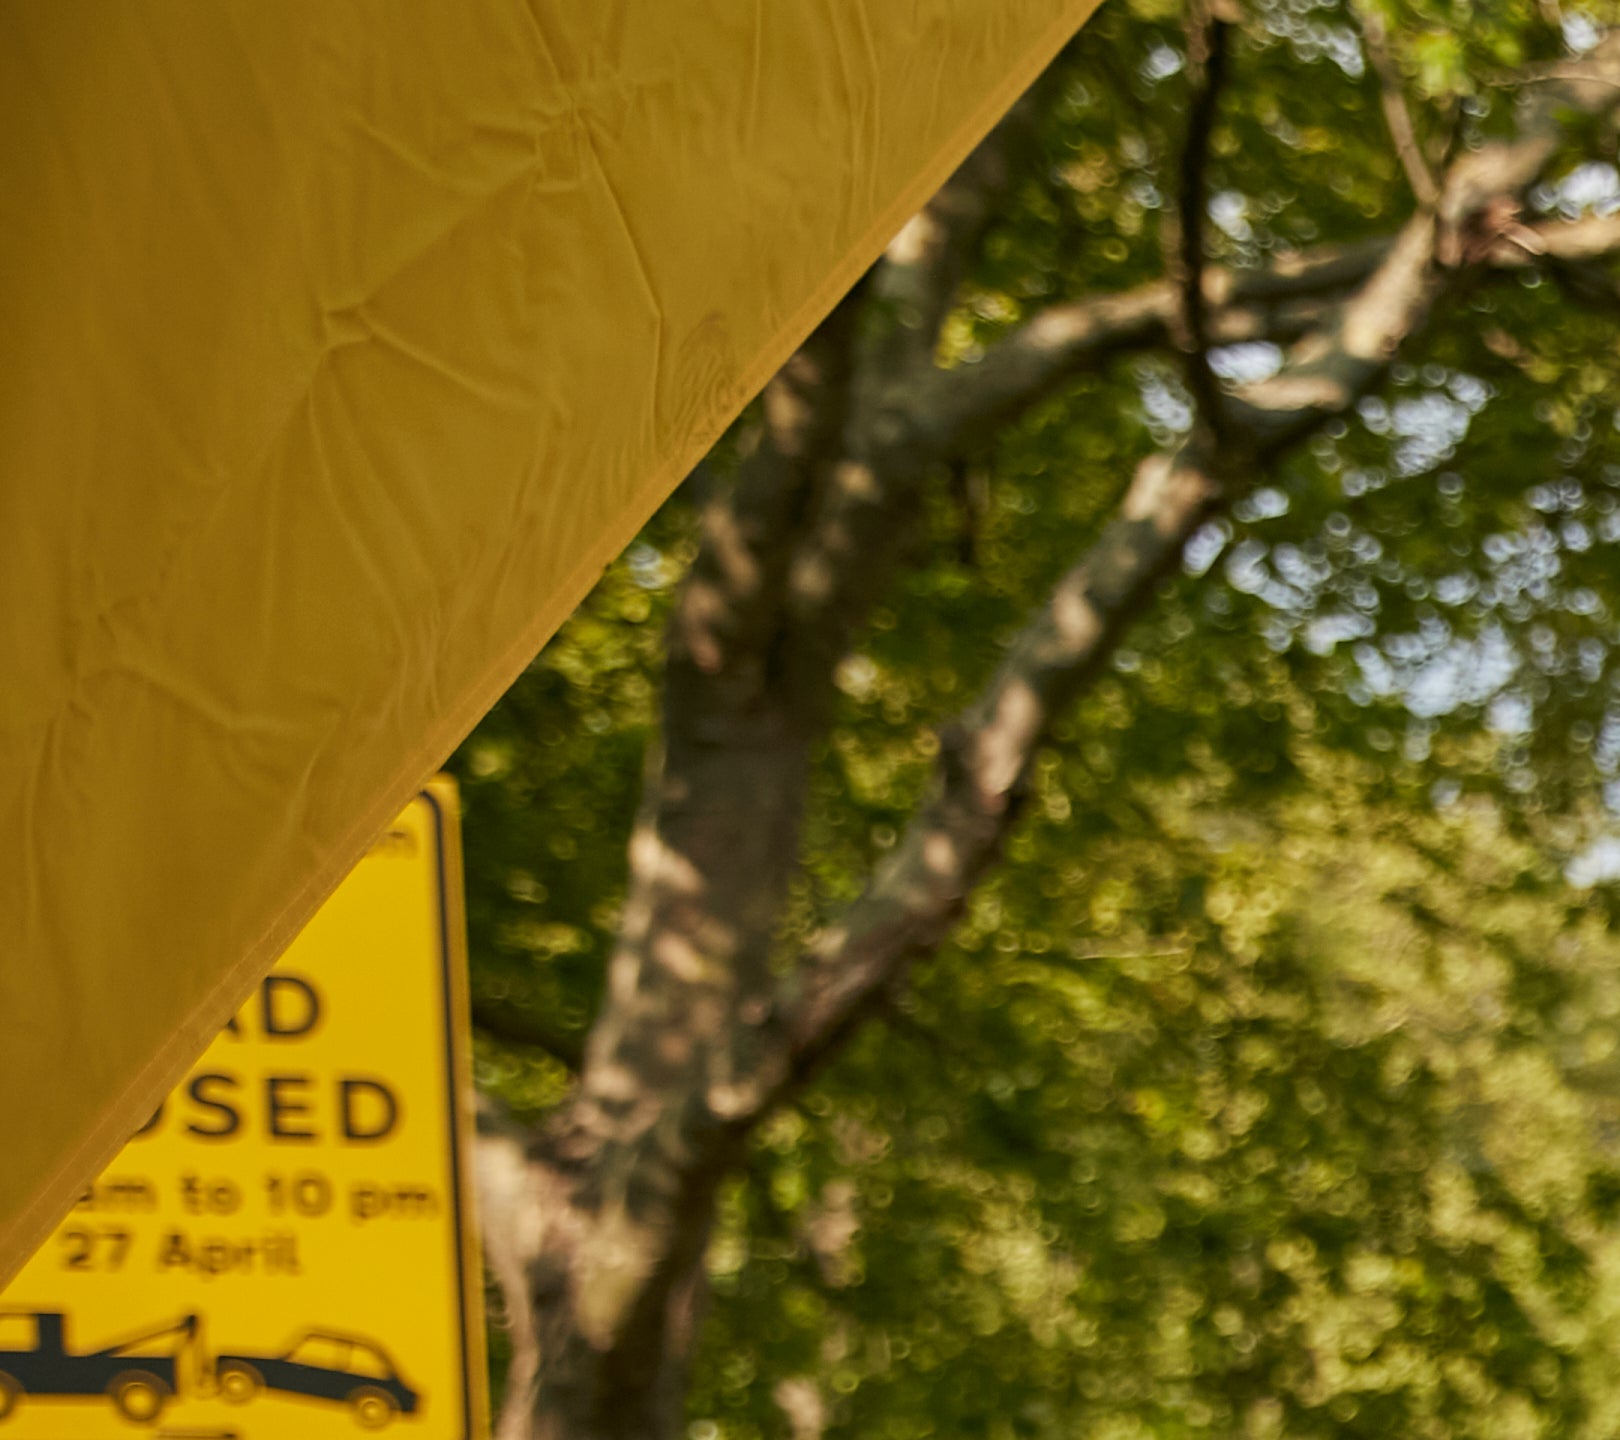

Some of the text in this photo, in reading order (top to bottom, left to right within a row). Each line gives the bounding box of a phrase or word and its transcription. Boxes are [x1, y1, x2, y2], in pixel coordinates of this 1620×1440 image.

[130, 1072, 400, 1140] SED
[181, 1171, 243, 1216] to
[265, 1169, 334, 1218] 10
[349, 1178, 441, 1224] pm
[61, 1227, 301, 1277] 27 April
